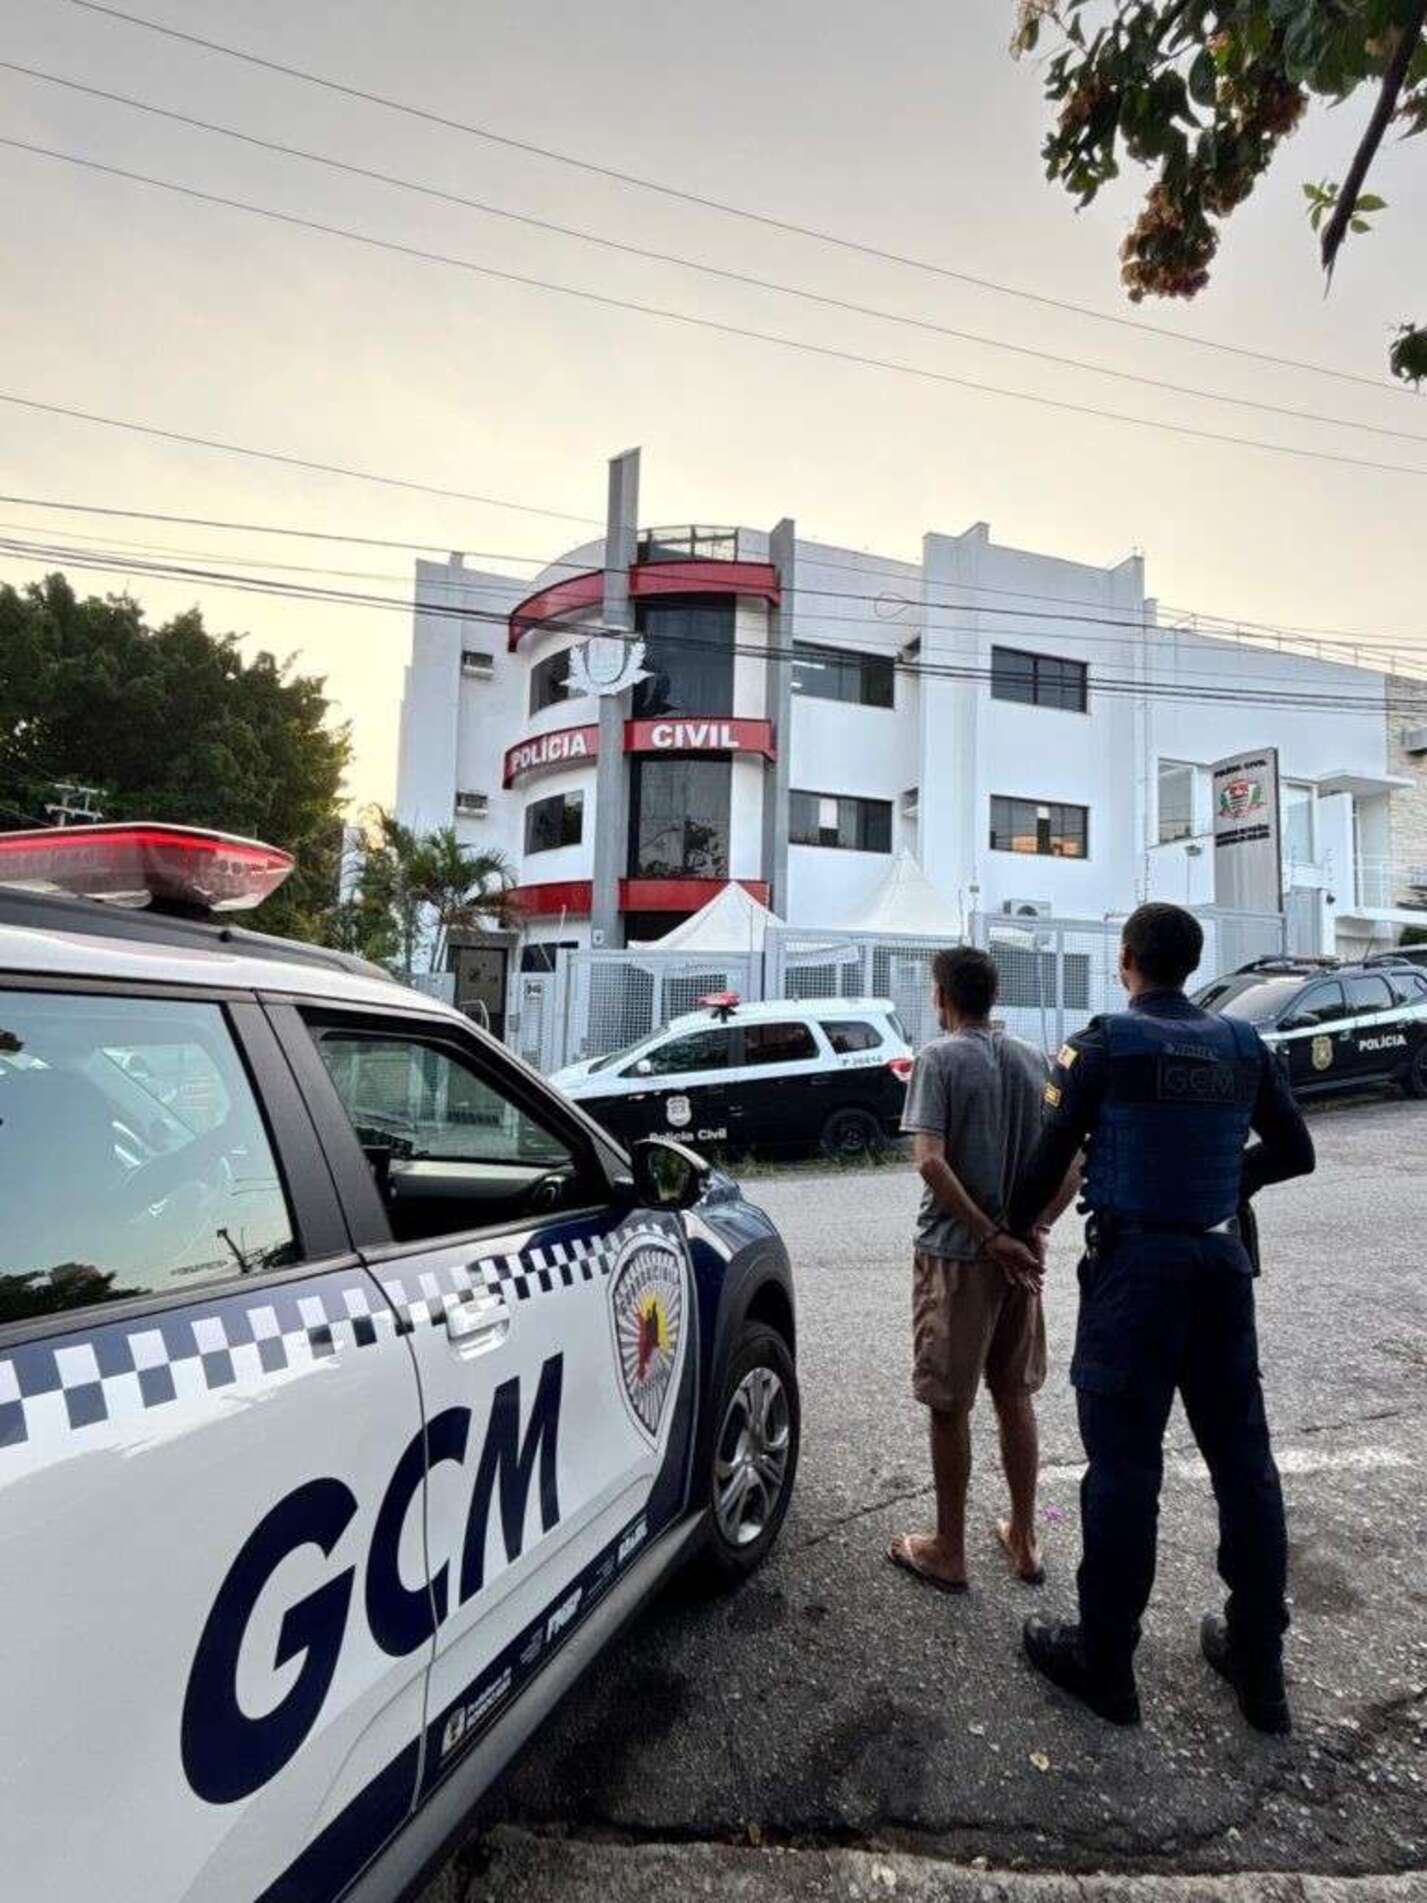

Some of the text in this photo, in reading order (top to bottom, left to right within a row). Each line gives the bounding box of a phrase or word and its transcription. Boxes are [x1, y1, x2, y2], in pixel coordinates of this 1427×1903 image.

[511, 724, 739, 770] POLÍCIA CIVIL
[1359, 1034, 1407, 1051] POLÍCIA
[698, 1128, 727, 1140] Civil
[181, 1352, 564, 1804] GCM
